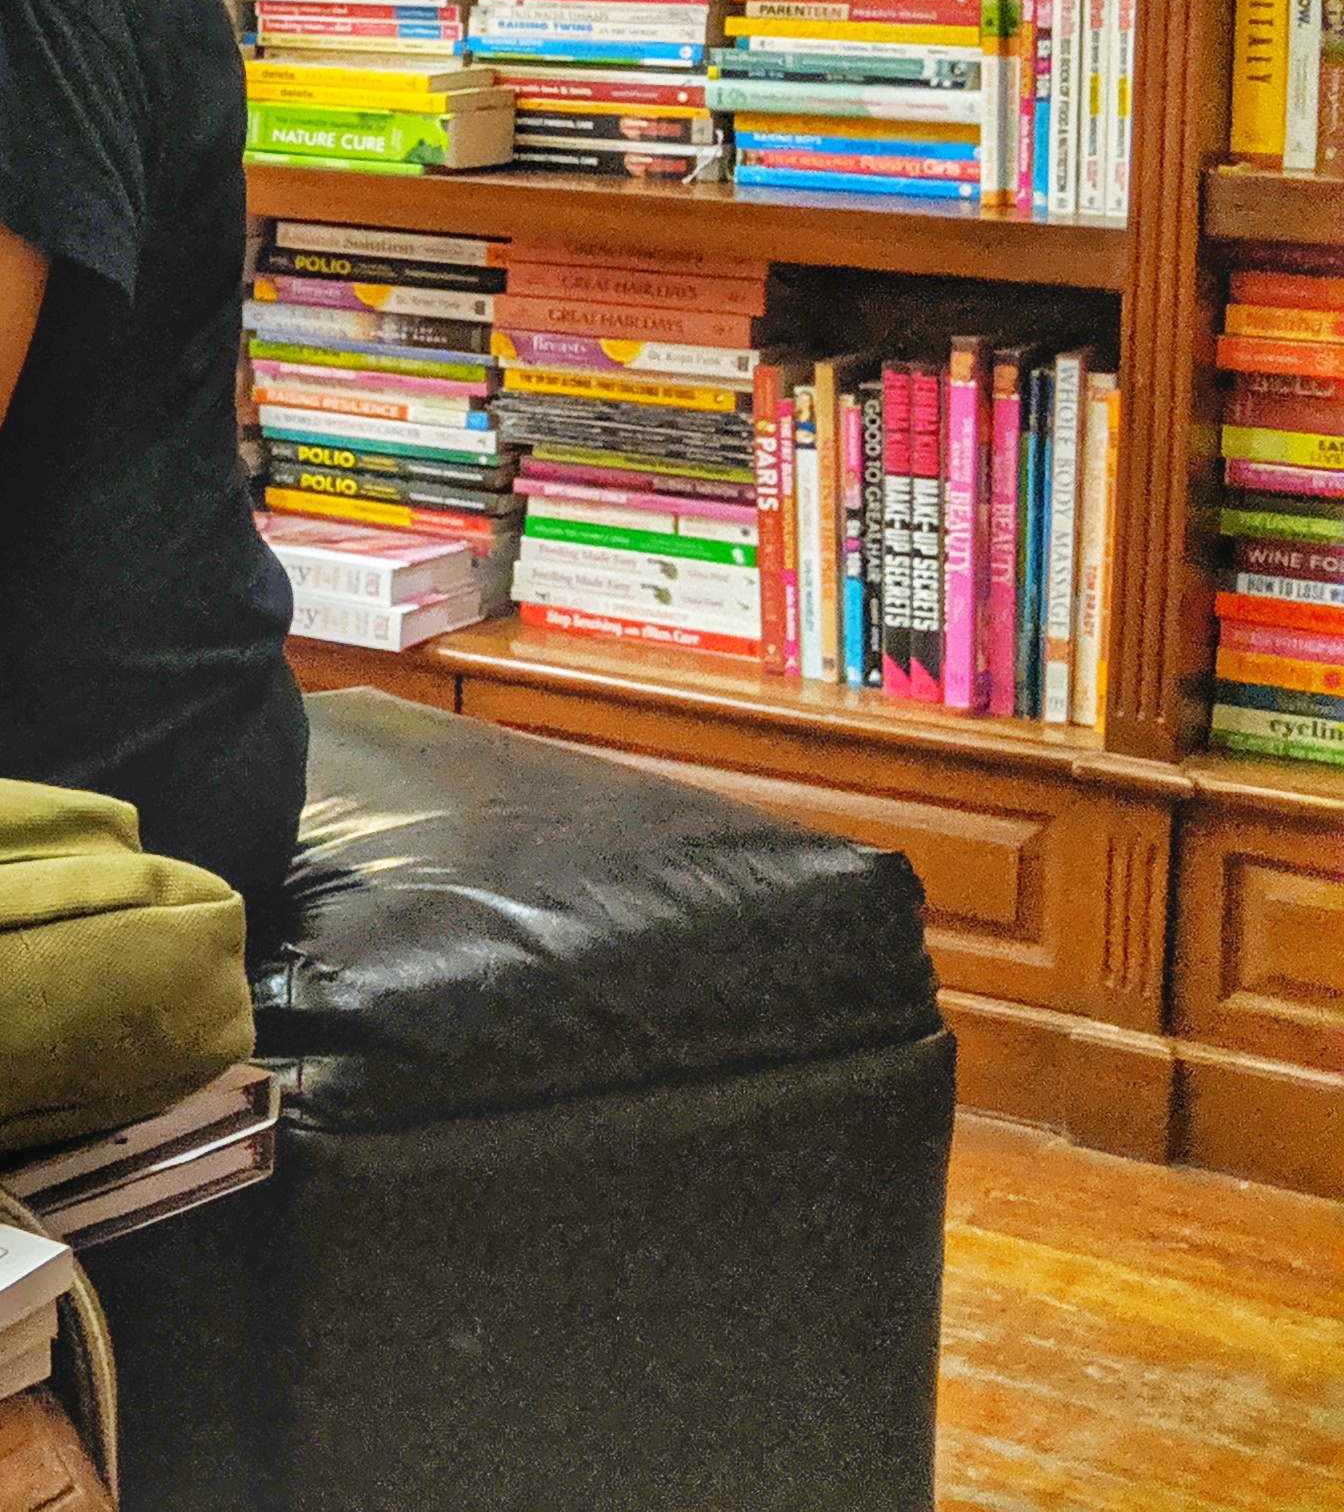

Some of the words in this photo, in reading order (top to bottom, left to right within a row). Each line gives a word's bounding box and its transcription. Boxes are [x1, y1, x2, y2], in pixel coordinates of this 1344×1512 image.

[497, 21, 548, 31] RAISING
[553, 22, 593, 33] TWINS
[1247, 0, 1274, 85] ITALY
[262, 69, 295, 81] delete
[281, 89, 313, 99] delete
[272, 128, 335, 149] NATURE
[341, 133, 386, 153] CURE
[922, 159, 961, 176] Girls
[294, 257, 351, 274] POLIO
[781, 415, 793, 436] THE
[1056, 365, 1078, 447] WHOLE
[781, 437, 792, 458] FAT
[864, 400, 881, 456] GOOD
[298, 445, 356, 468] POLIO
[755, 437, 778, 511] PARIS
[865, 461, 881, 482] TO
[299, 473, 358, 496] POLIO
[781, 460, 793, 495] BURN
[1055, 457, 1074, 519] BODY
[865, 486, 881, 534] GREAT
[884, 476, 911, 553] MAKE-UP
[912, 478, 939, 556] MAKE-UP
[949, 491, 972, 574] BEAUTY
[992, 503, 1014, 585] BEAUTY
[866, 543, 881, 582] HAIR
[1250, 548, 1303, 569] WINE
[884, 554, 911, 627] SECRETS
[912, 557, 939, 631] SECRETS
[1049, 530, 1071, 630] MASSAGE
